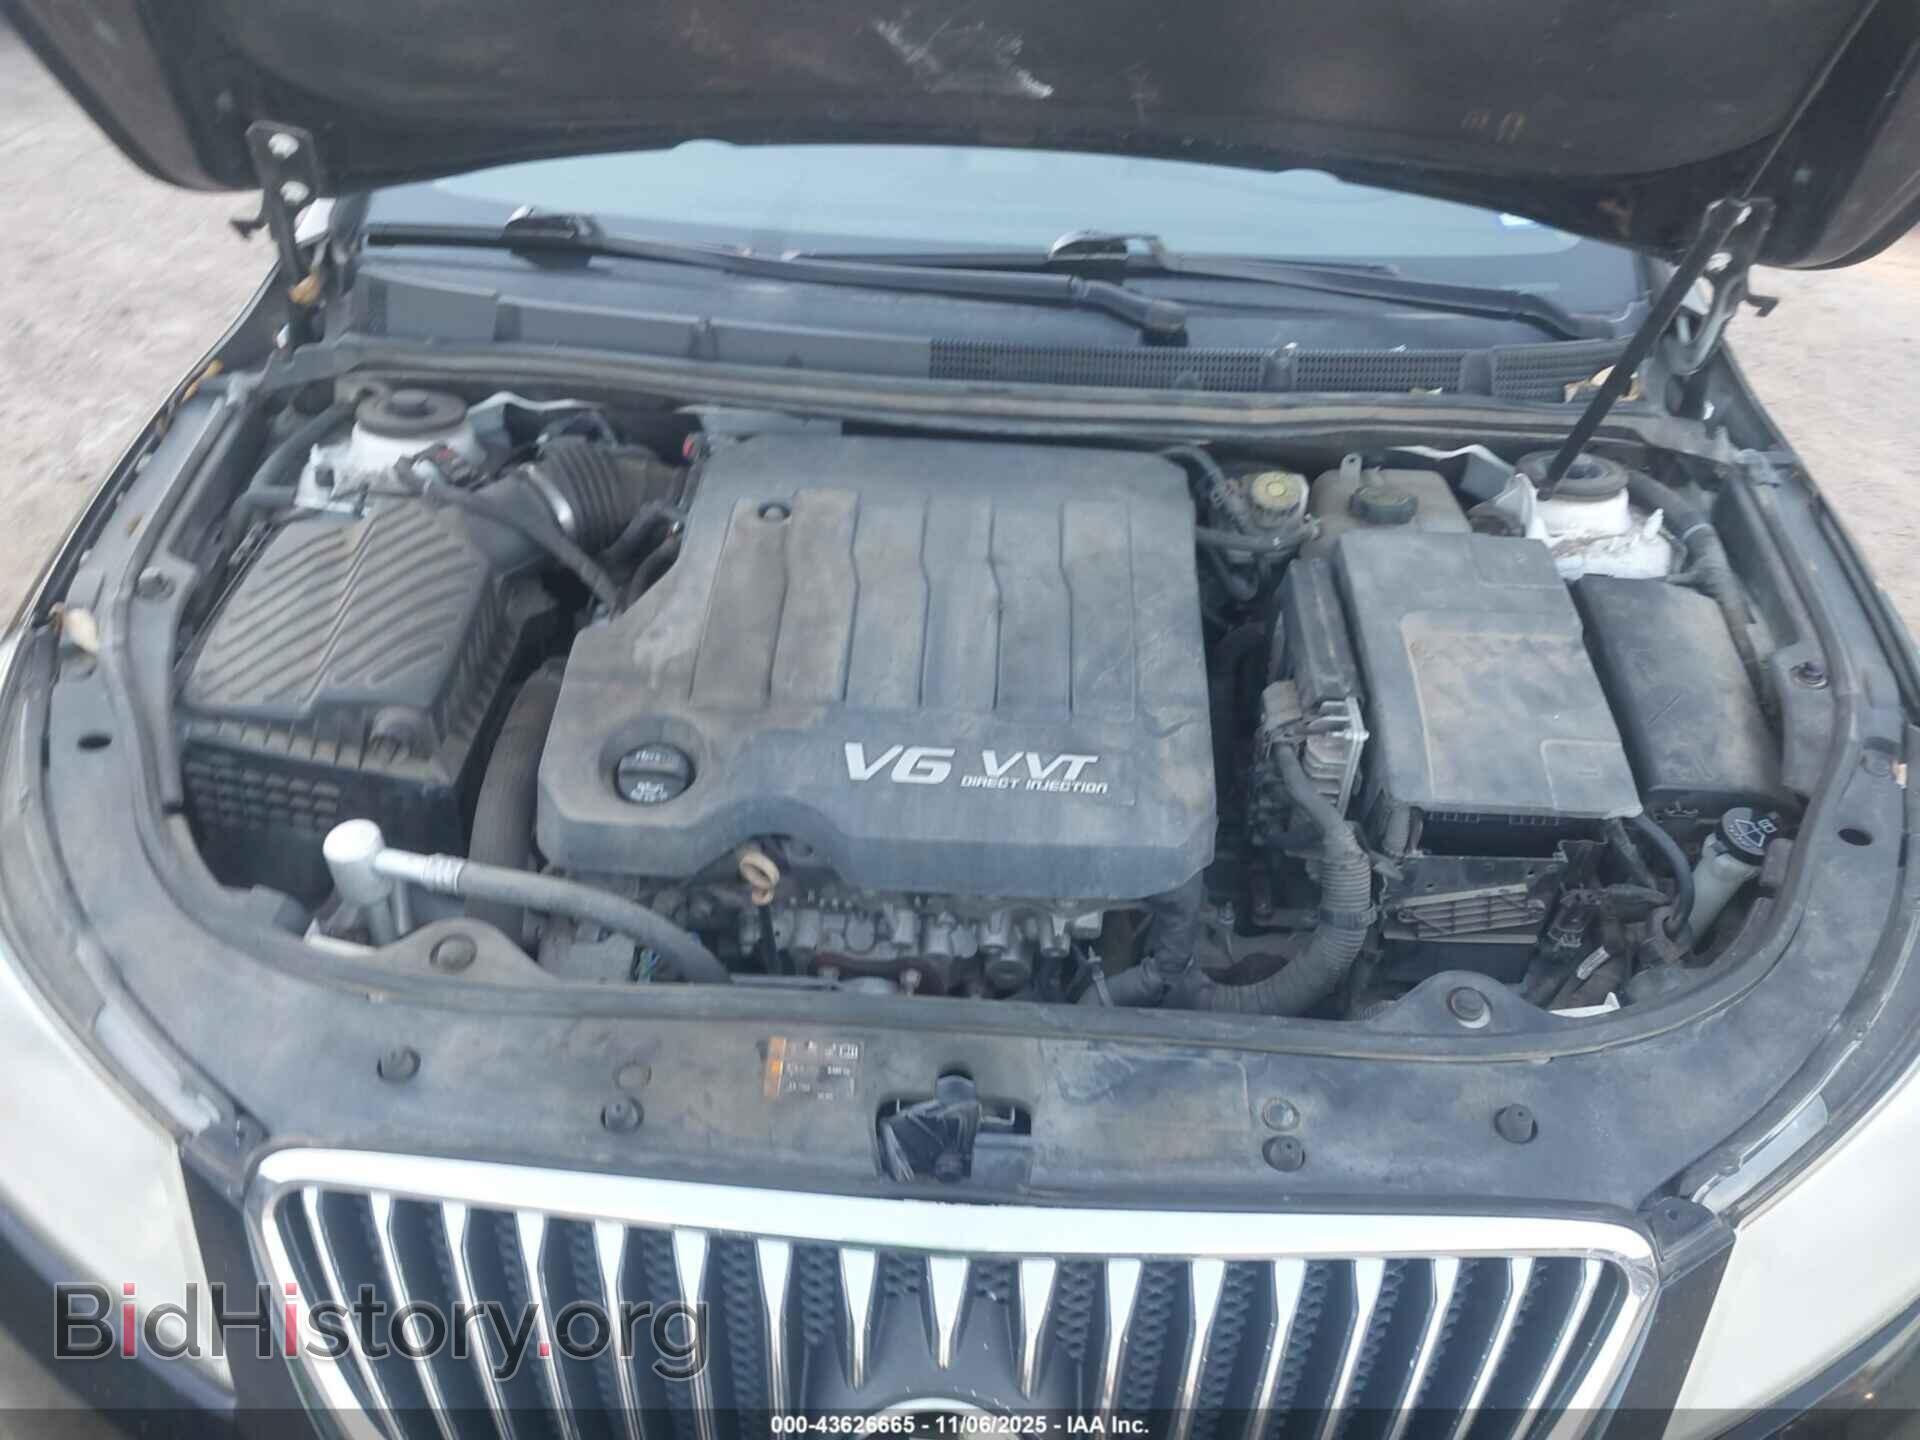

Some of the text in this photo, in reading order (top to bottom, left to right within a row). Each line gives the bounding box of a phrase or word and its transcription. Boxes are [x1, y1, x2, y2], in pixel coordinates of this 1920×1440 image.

[844, 742, 1099, 785] V6 VVT
[960, 775, 1108, 795] DIRECT INJECTION
